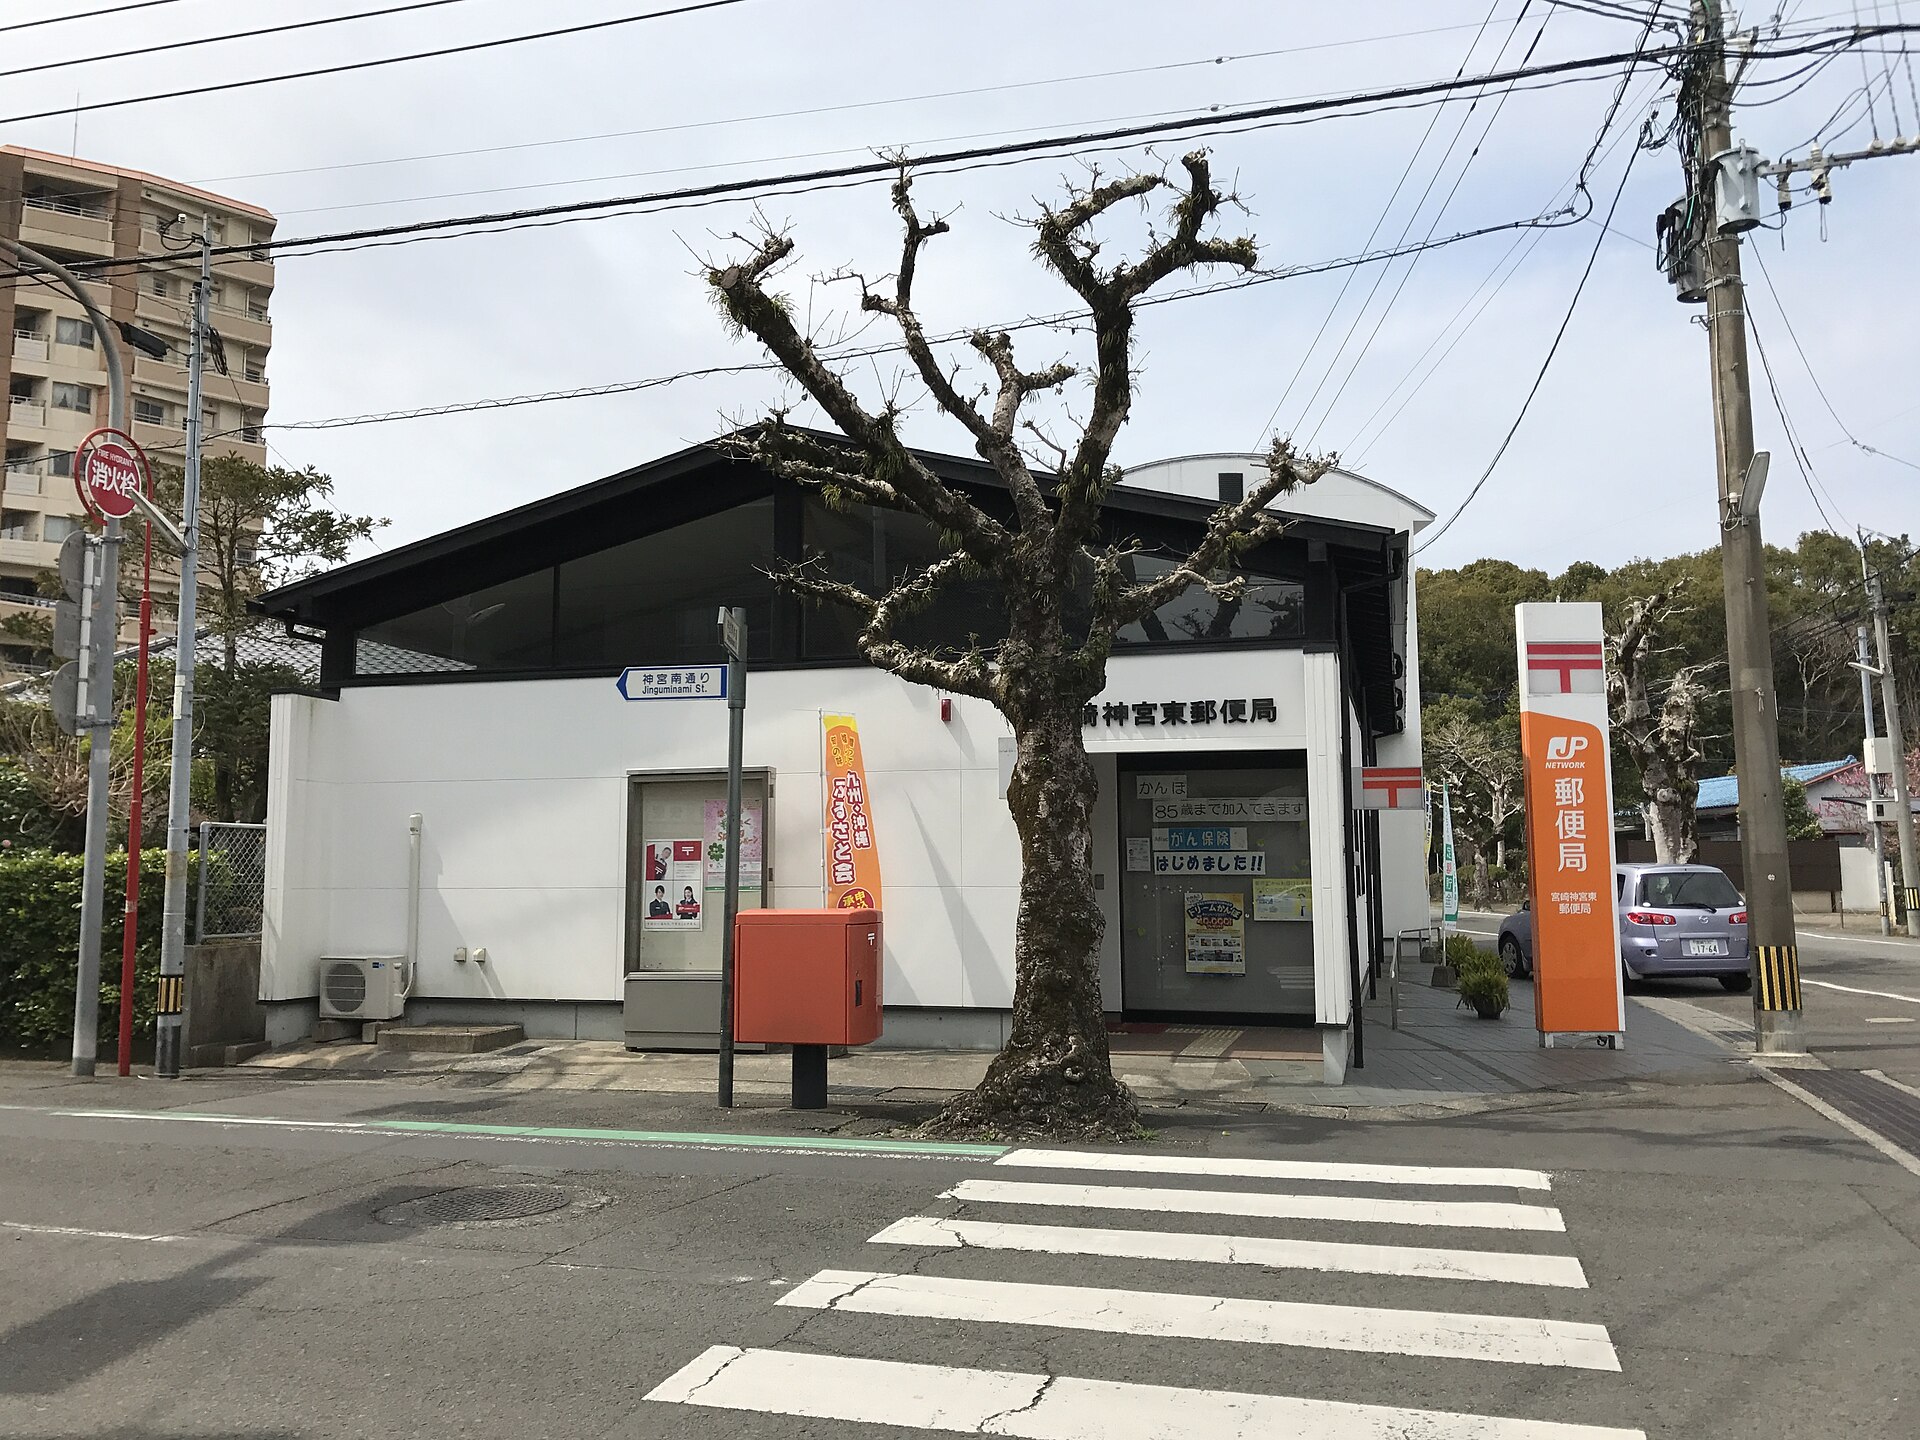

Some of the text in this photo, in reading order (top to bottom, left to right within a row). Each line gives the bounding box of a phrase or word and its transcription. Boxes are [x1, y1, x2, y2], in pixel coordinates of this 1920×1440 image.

[97, 448, 133, 467] FIRE HYDRANT
[91, 459, 137, 498] 消火栓
[642, 672, 710, 685] 神宮南通り
[641, 683, 708, 696] Jinguminami St.
[1545, 761, 1586, 769] NETWORK
[1555, 777, 1588, 873] 郵便局
[1170, 830, 1230, 847] がん保険
[1551, 891, 1598, 902] 宮崎神宮東
[1559, 903, 1592, 915] 郵便局
